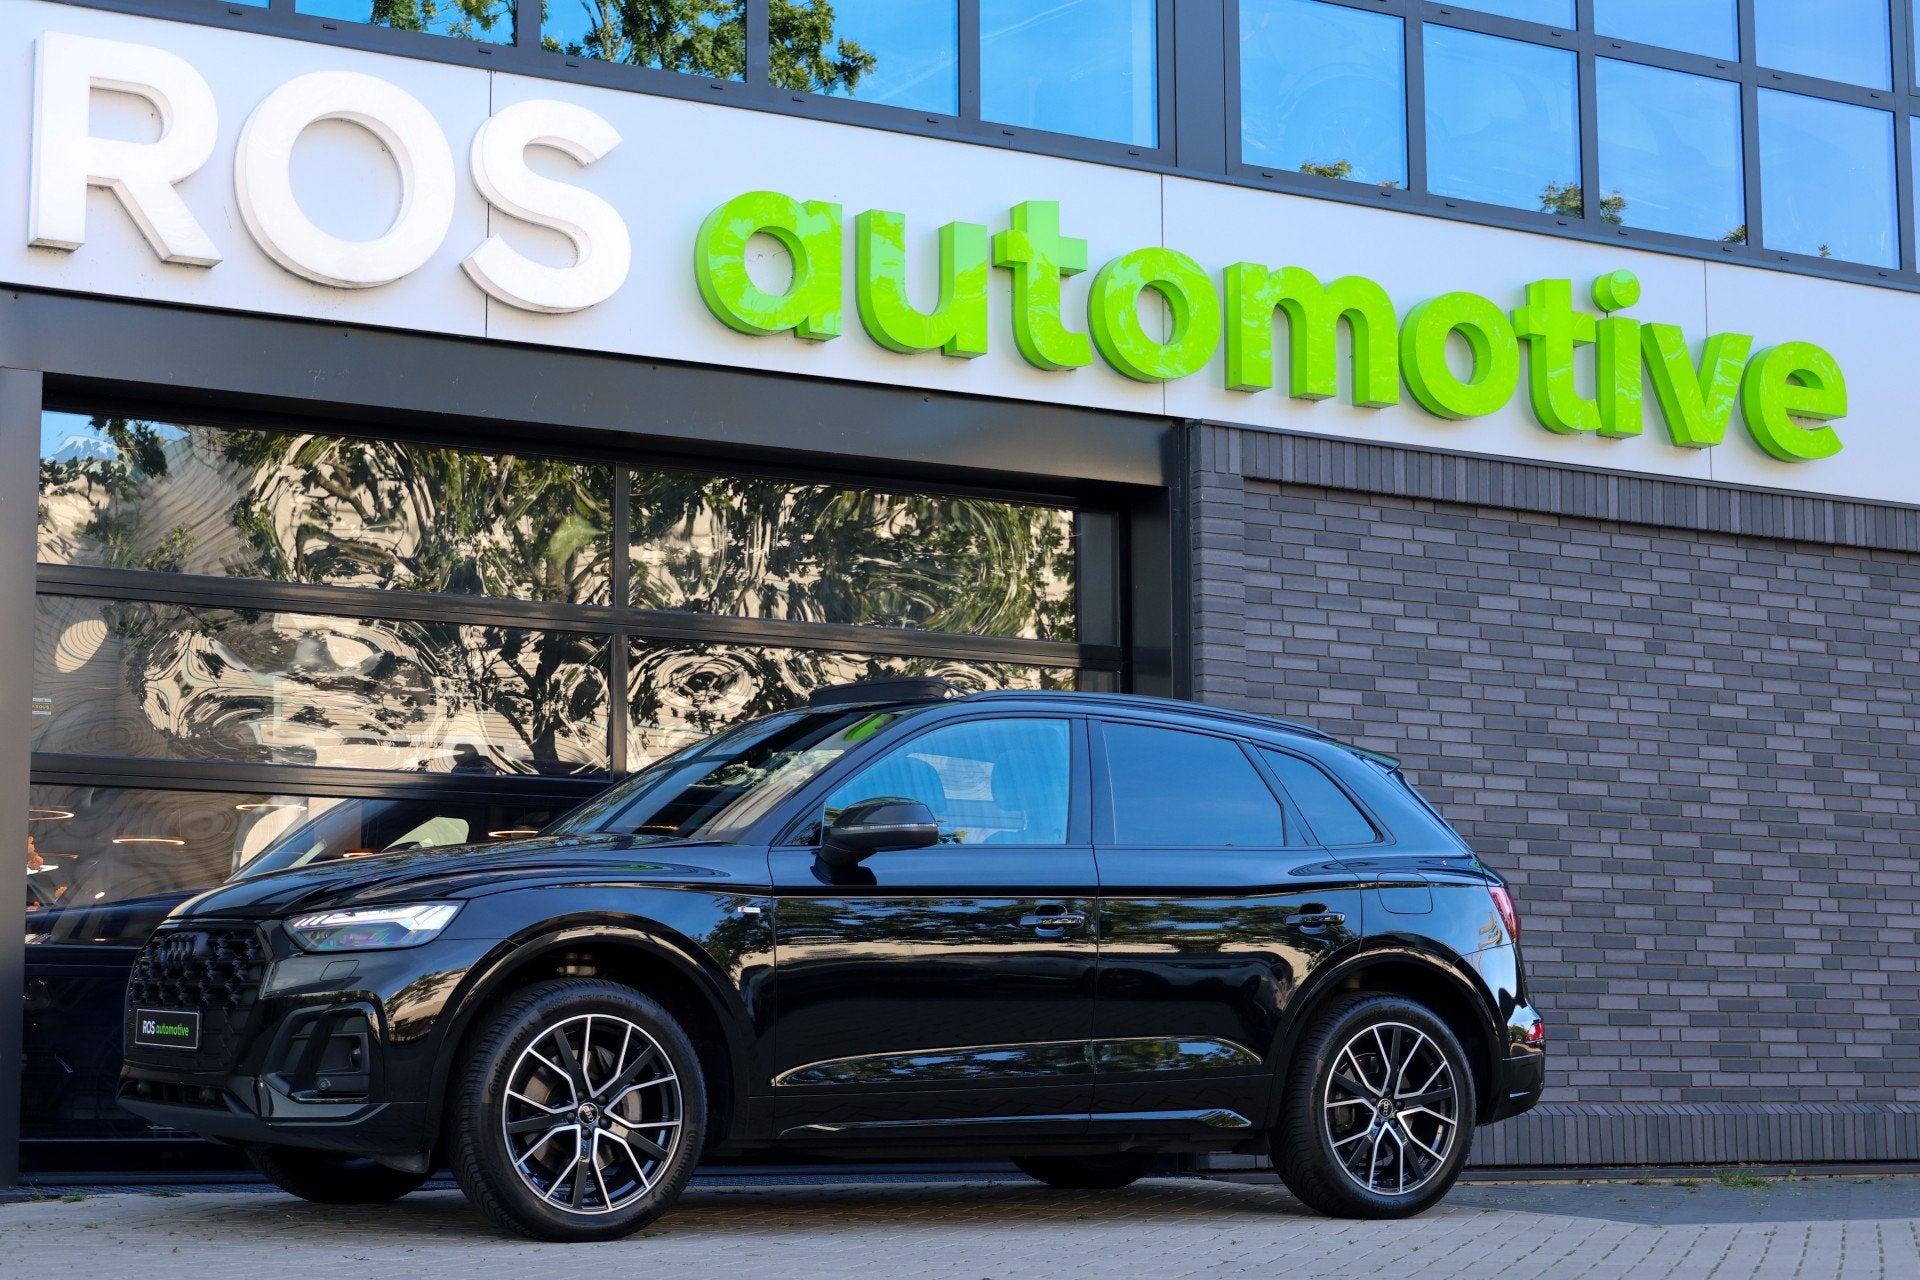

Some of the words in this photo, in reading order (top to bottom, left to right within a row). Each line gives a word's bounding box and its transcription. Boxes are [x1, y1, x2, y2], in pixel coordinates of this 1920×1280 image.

[27, 30, 631, 314] ROS
[694, 190, 1848, 463] automotive
[142, 1020, 155, 1034] ROS
[156, 1023, 189, 1036] automotive
